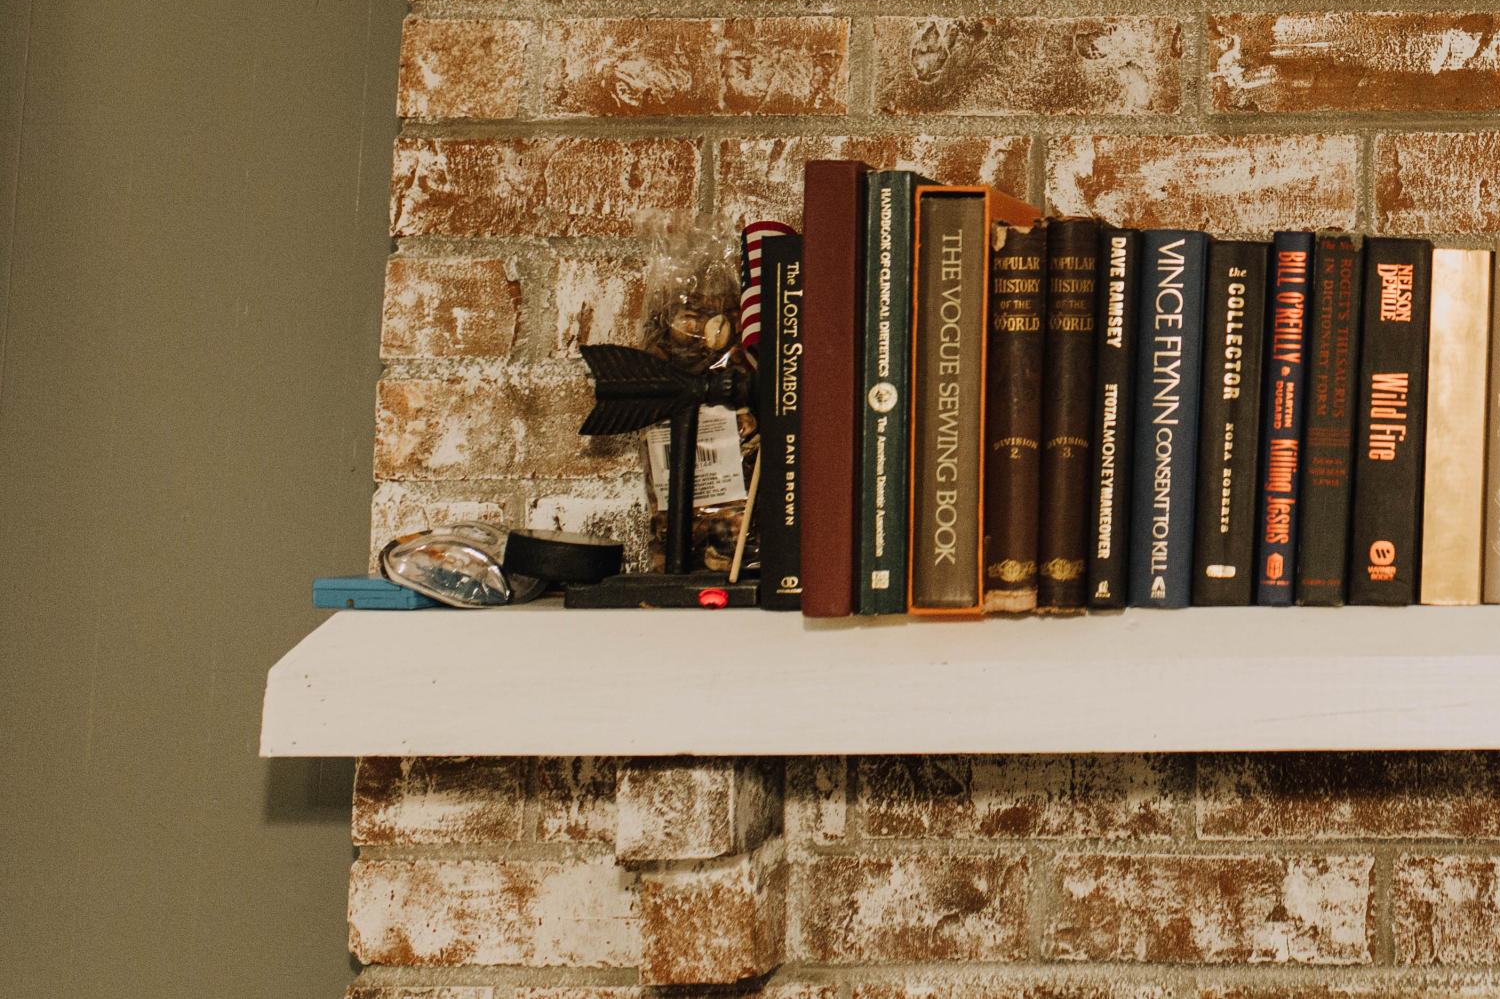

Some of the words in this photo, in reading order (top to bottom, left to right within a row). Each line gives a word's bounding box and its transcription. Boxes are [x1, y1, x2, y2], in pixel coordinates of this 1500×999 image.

[880, 188, 892, 250] HANDBOOK
[787, 262, 799, 285] The
[880, 252, 891, 268] OF
[942, 229, 963, 281] THE
[993, 257, 1040, 270] POPULAR
[1110, 237, 1127, 278] DAVE
[1229, 267, 1247, 278] the
[1277, 251, 1307, 287] BILL
[1324, 257, 1335, 274] IN
[879, 268, 891, 317] CLINICAL
[995, 279, 1040, 294] HISTORY
[1000, 300, 1010, 309] OF
[1013, 300, 1031, 310] THE
[1051, 279, 1096, 293] HISTORY
[1069, 301, 1085, 310] THE
[1155, 238, 1186, 330] VINCE
[1338, 258, 1353, 321] ROGET'S
[1395, 264, 1413, 322] NELSON
[783, 289, 803, 338] LOST
[939, 284, 962, 376] VOGUE
[994, 317, 1040, 331] WORLD
[1049, 318, 1094, 331] WORLD
[1106, 281, 1125, 349] RAMSEY
[1273, 291, 1305, 364] O'REILLY
[1320, 279, 1334, 366] DICTIONARY
[878, 321, 890, 378] DIETETICS
[1223, 282, 1246, 400] COLLECTOR
[782, 342, 802, 416] SYMBOL
[1152, 336, 1182, 425] FLYNN
[1316, 375, 1329, 416] FORM
[1333, 327, 1350, 418] THESAURUS
[1370, 373, 1409, 419] Wild
[1103, 390, 1118, 430] TOTAL
[1273, 380, 1284, 430] DUGARD
[1284, 382, 1295, 428] MARTIN
[786, 434, 795, 464] DAN
[936, 382, 960, 483] SEWING
[993, 437, 1038, 450] DIVISION
[1224, 422, 1234, 461] NORA
[1368, 423, 1407, 461] Fire
[1101, 430, 1116, 488] MONEY
[1153, 428, 1172, 512] CONSENT
[1265, 439, 1299, 493] Killing
[785, 472, 795, 526] BROWN
[1097, 487, 1113, 559] MAKEOVER
[1220, 468, 1232, 533] ROBERTS
[1265, 498, 1296, 544] Jesus
[934, 490, 957, 567] BOOK
[1152, 512, 1170, 539] TO
[1151, 541, 1168, 575] KILL
